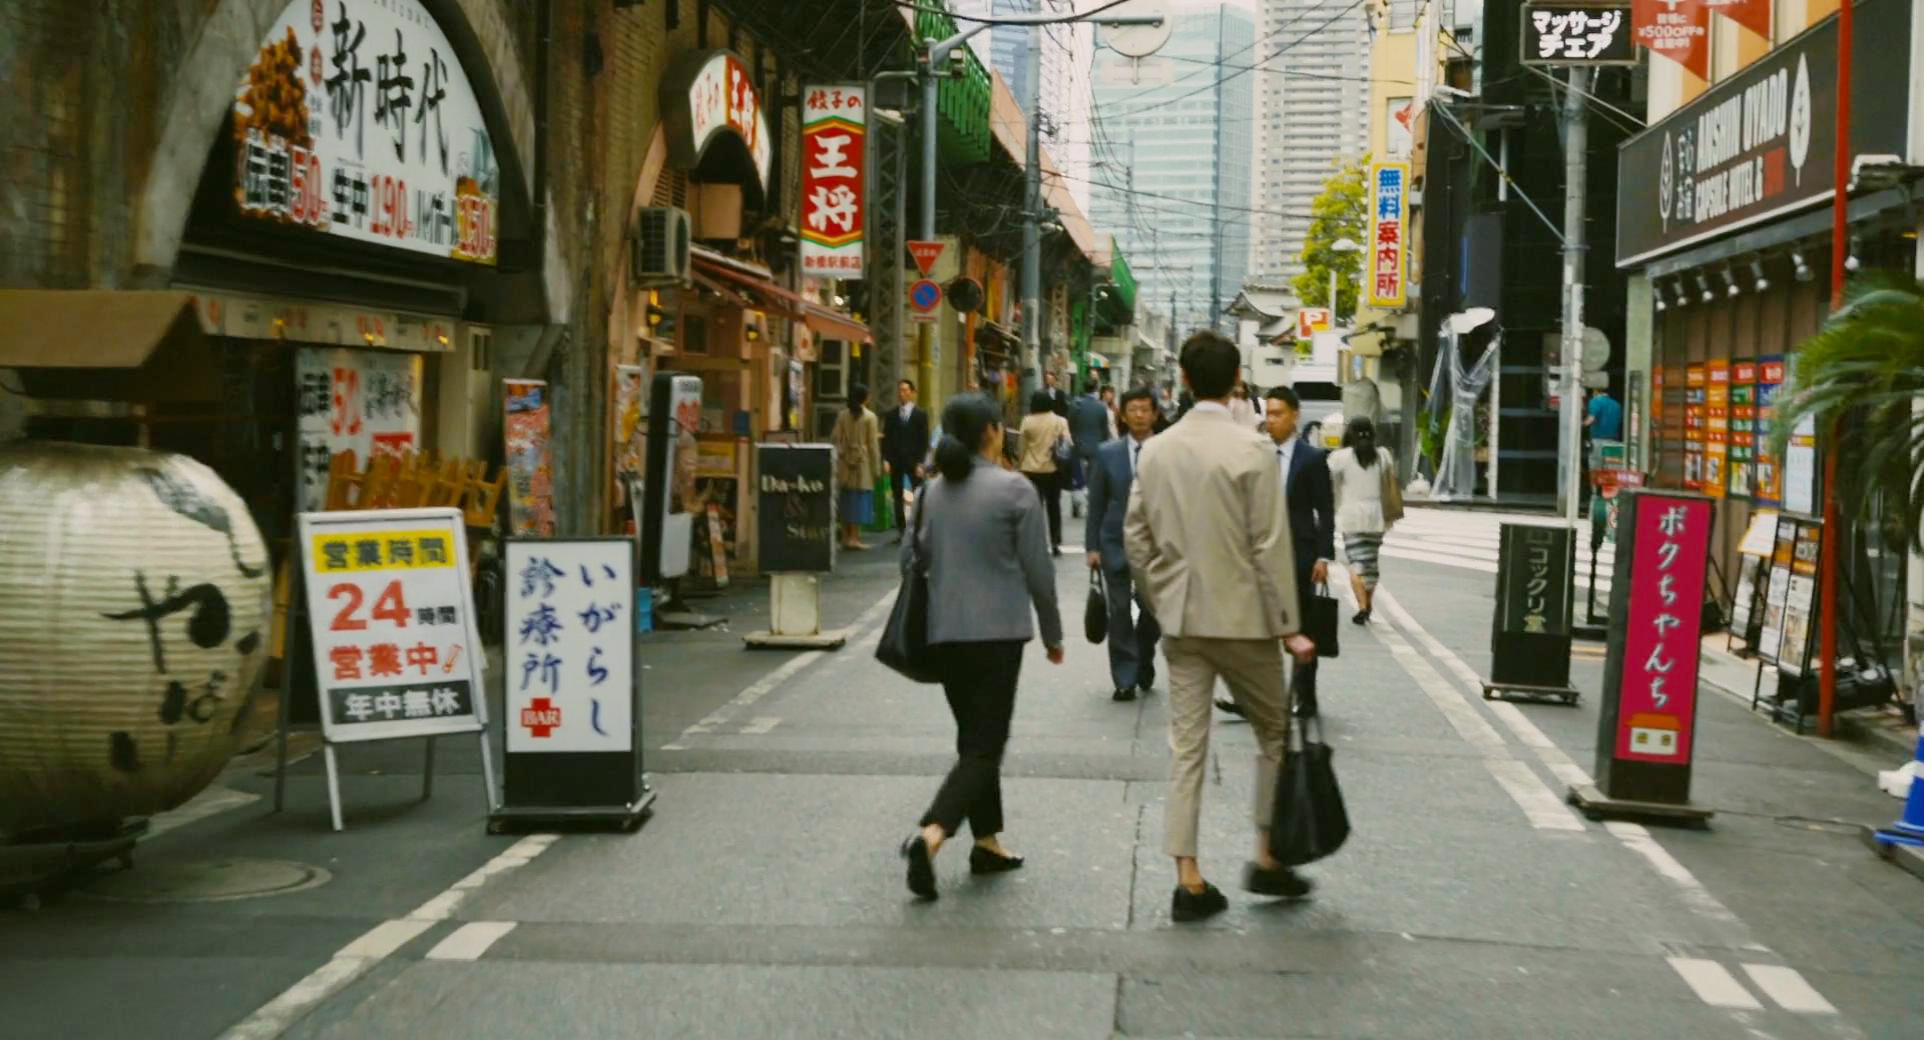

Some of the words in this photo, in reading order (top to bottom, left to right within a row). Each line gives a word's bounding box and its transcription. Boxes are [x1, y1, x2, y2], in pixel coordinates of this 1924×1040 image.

[1532, 10, 1622, 35] マッサージ
[1539, 33, 1613, 58] チェア
[325, 1, 449, 178] 新時代
[807, 90, 861, 110] 餃子の
[1743, 68, 1787, 152] OYADO
[809, 134, 859, 232] 王将
[1376, 169, 1400, 297] 無料案内所
[323, 537, 446, 569] 営業時間
[519, 556, 567, 695] 診療所
[578, 561, 622, 737] いがらし
[345, 688, 460, 720] 年中無休
[523, 711, 560, 727] BAR
